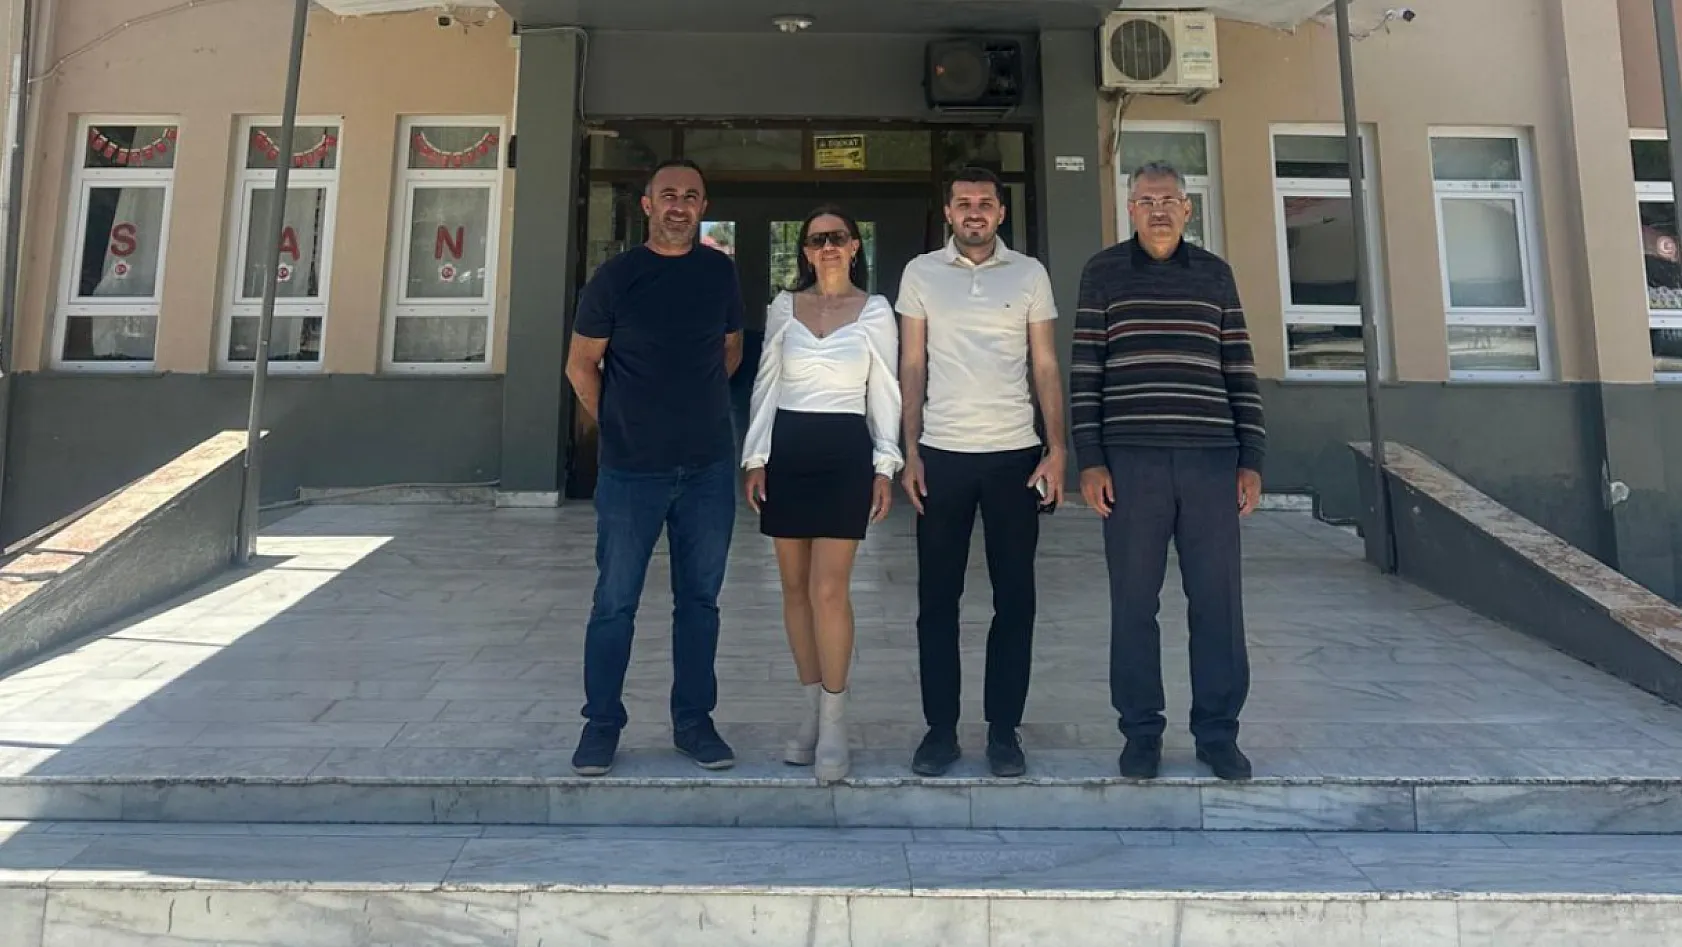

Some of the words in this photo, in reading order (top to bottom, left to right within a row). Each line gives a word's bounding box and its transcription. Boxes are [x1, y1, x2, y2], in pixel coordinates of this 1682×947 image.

[110, 223, 137, 257] S
[279, 226, 300, 260] A
[433, 223, 463, 260] N
